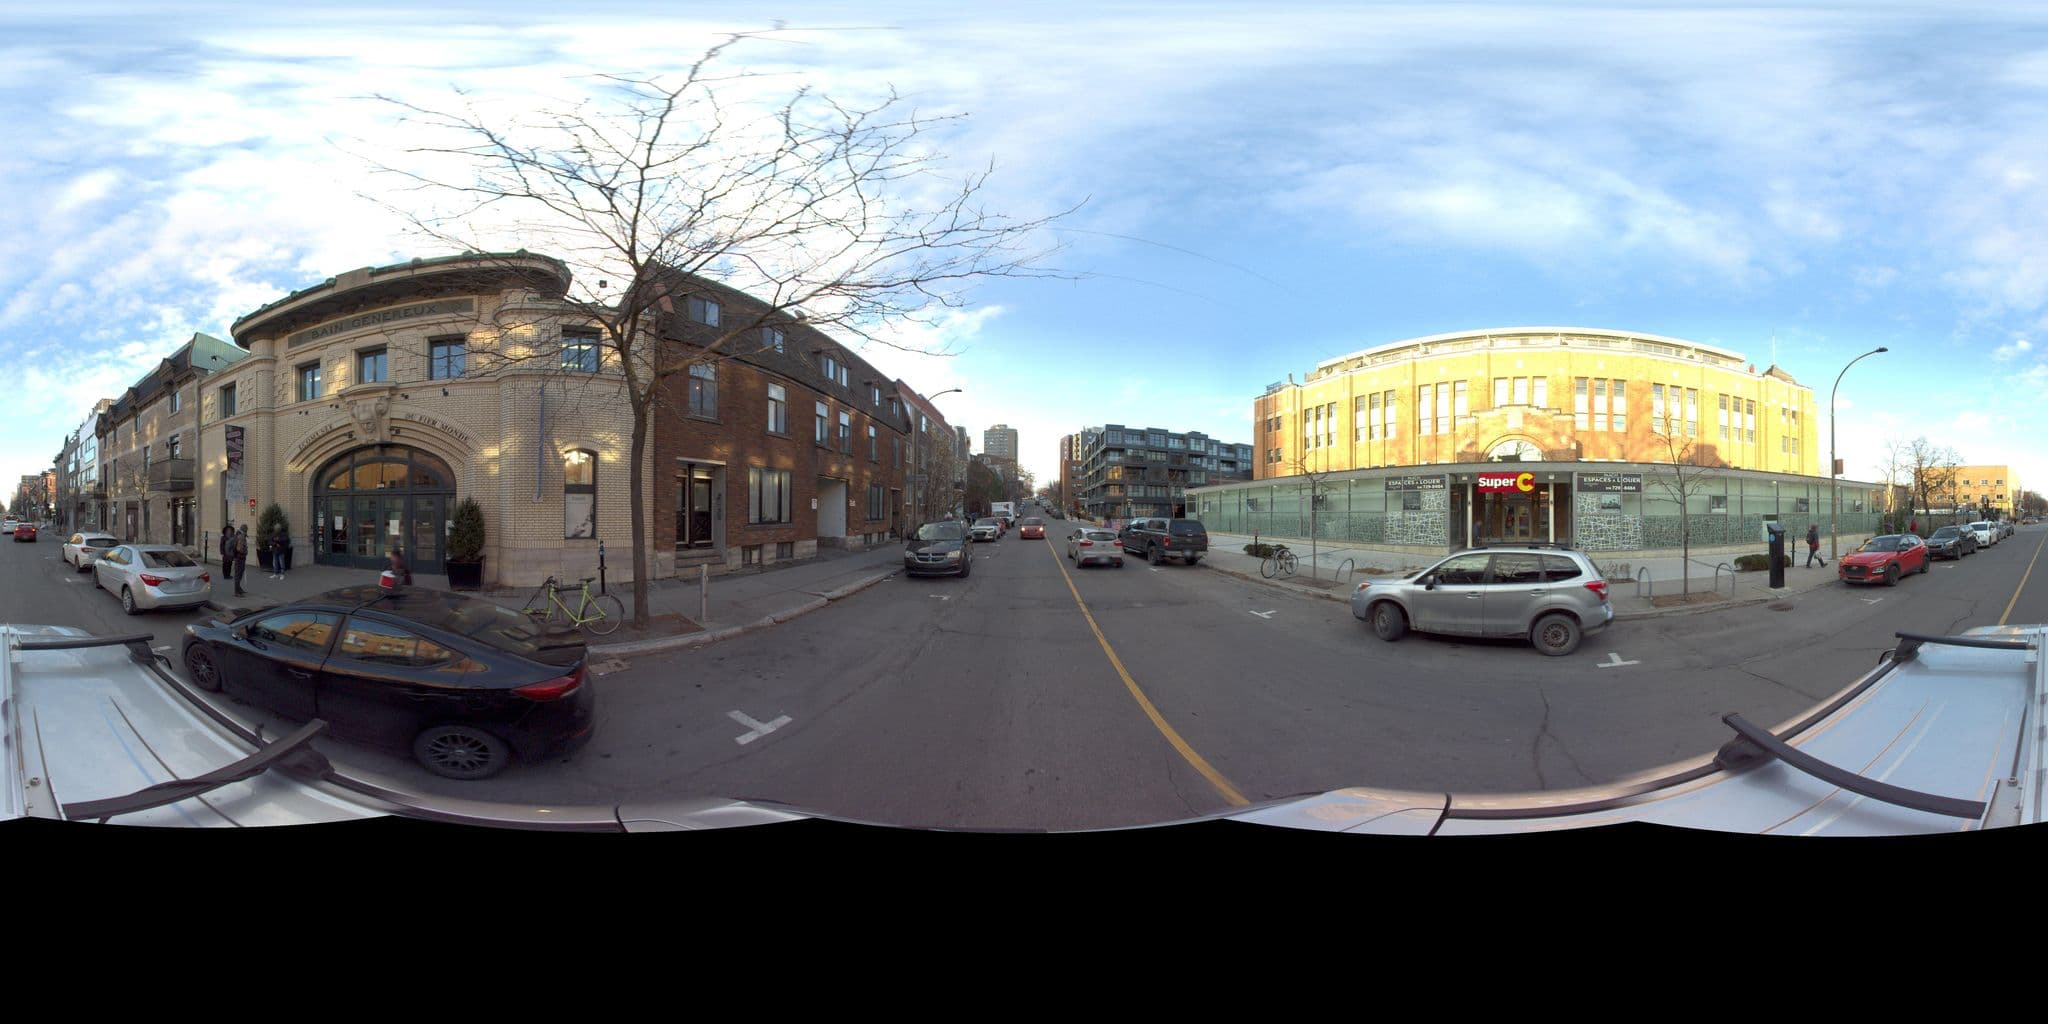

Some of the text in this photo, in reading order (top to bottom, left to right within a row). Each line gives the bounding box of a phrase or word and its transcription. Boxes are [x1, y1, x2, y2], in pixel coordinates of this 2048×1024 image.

[311, 323, 344, 340] BAIN
[1478, 472, 1535, 492] Super C
